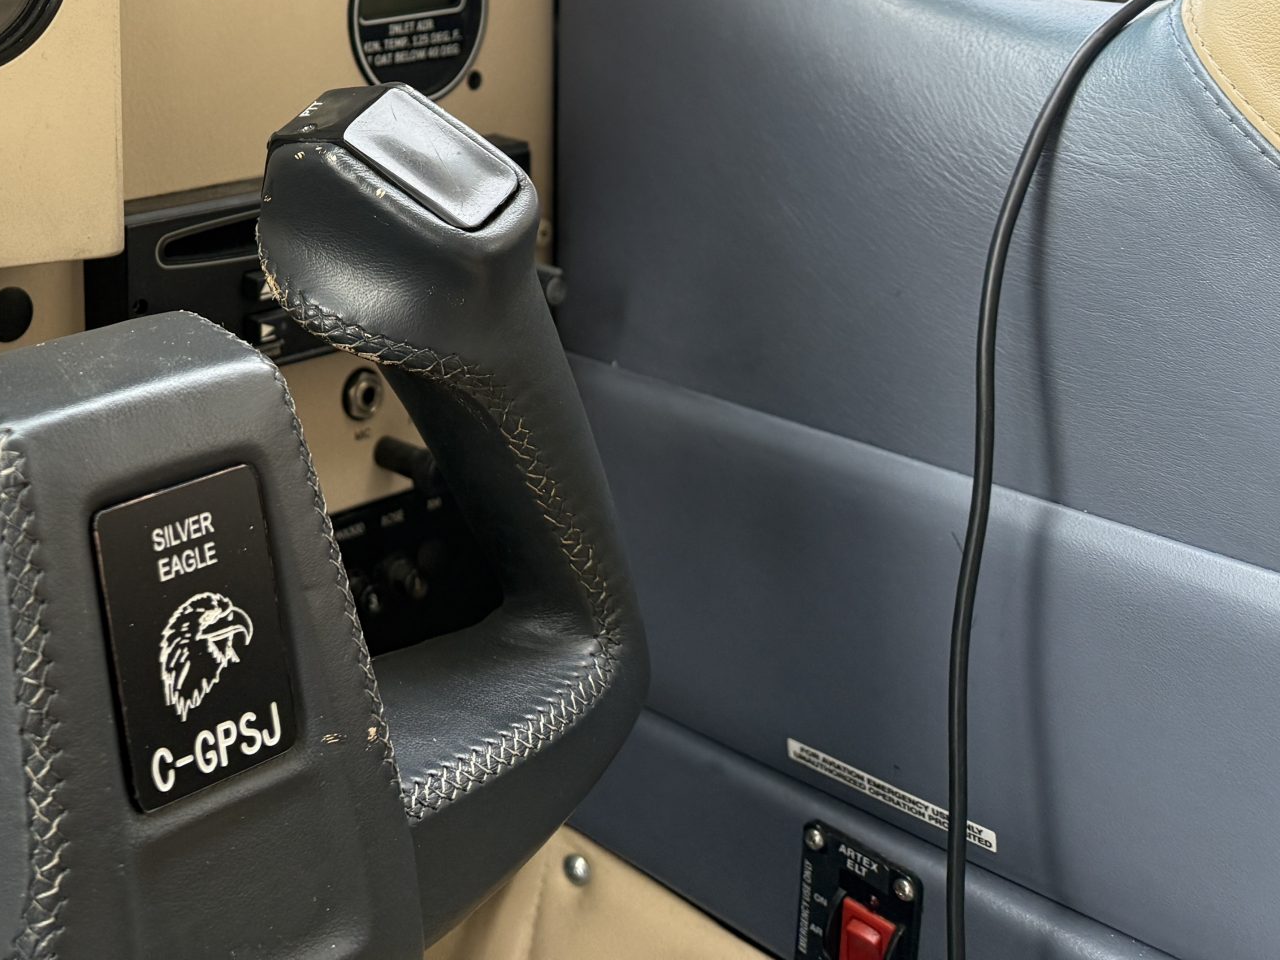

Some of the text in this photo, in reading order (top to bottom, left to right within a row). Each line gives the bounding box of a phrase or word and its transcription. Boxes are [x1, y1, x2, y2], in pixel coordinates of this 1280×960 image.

[151, 511, 215, 552] SILVER
[158, 541, 218, 582] EAGLE
[150, 701, 282, 793] C-GPSJ
[838, 844, 878, 873] ARTEX
[846, 859, 868, 877] ELT
